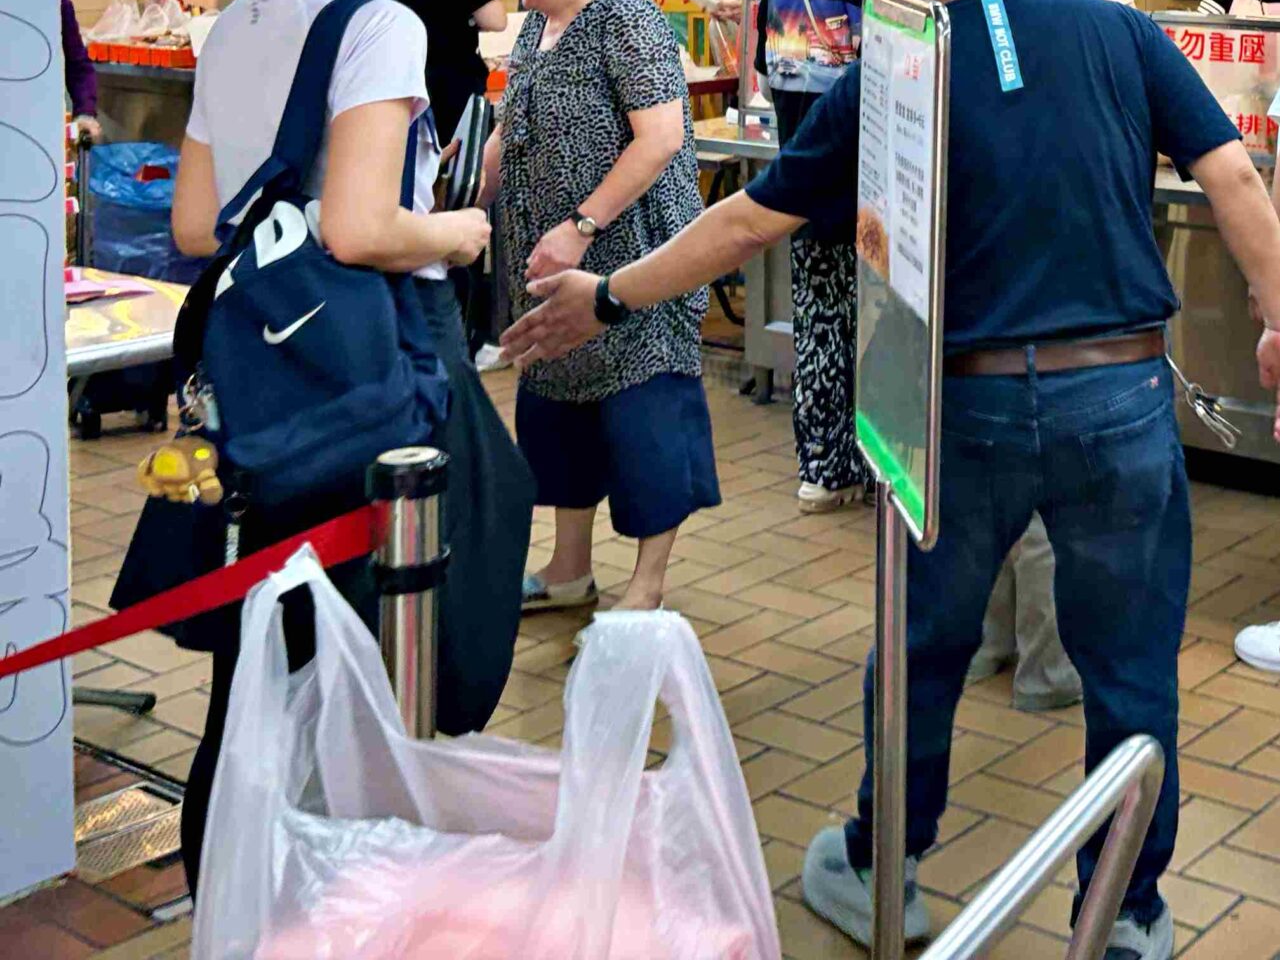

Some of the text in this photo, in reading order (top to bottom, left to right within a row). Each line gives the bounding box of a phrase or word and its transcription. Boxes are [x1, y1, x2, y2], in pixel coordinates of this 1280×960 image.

[1164, 28, 1265, 64] 勿重壓
[1000, 48, 1017, 82] CLUB
